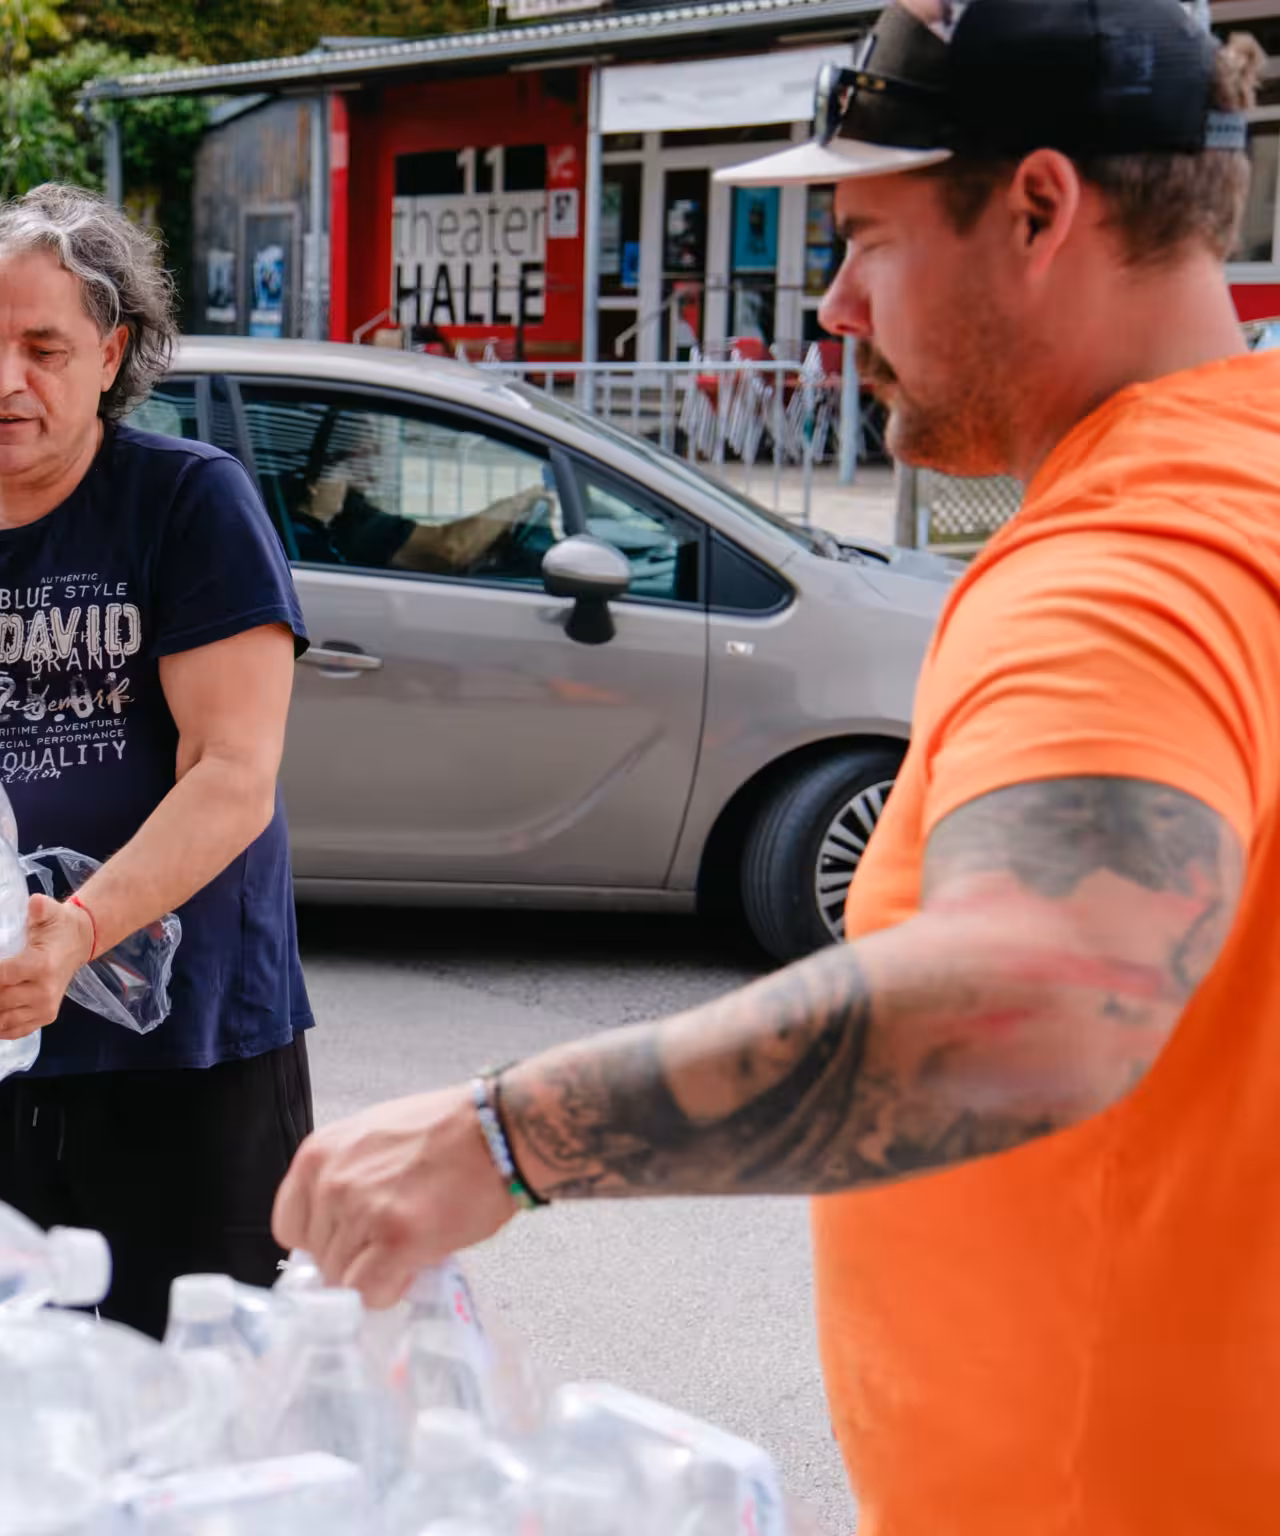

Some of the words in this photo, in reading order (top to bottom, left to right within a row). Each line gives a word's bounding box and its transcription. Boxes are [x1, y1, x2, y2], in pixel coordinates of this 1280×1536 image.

[456, 145, 505, 195] 11
[393, 197, 547, 257] theater
[396, 262, 545, 326] HALLE
[40, 572, 99, 585] AUTHENTIC
[64, 582, 128, 599] STYLE
[30, 647, 127, 675] BRAND
[36, 729, 125, 746] PERFORMANCE
[3, 740, 127, 772] QUALITY
